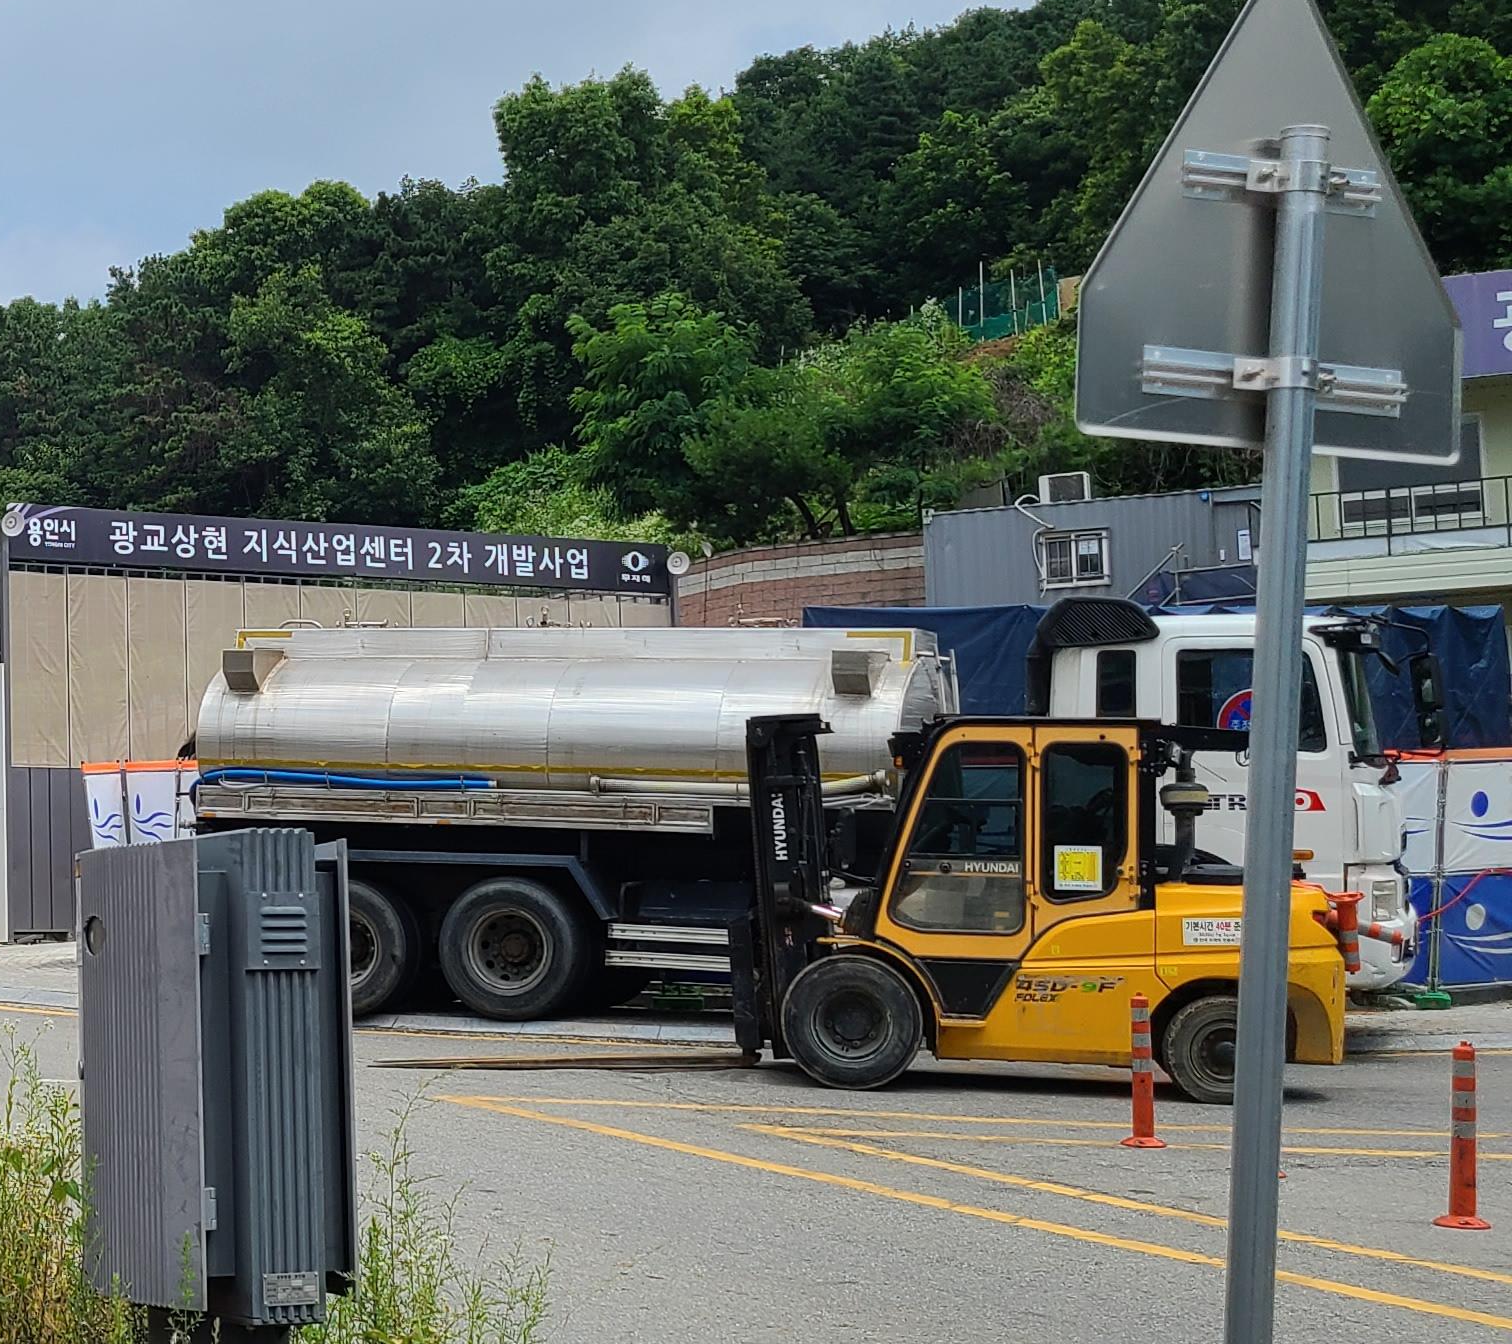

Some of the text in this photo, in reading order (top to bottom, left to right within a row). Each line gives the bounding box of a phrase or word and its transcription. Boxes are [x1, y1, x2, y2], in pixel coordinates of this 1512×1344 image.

[27, 517, 589, 580] 용인시 광교상현 지식산업센터 2차 개발사업
[964, 862, 1019, 873] HYUNDAI
[1185, 921, 1214, 932] 기본시간
